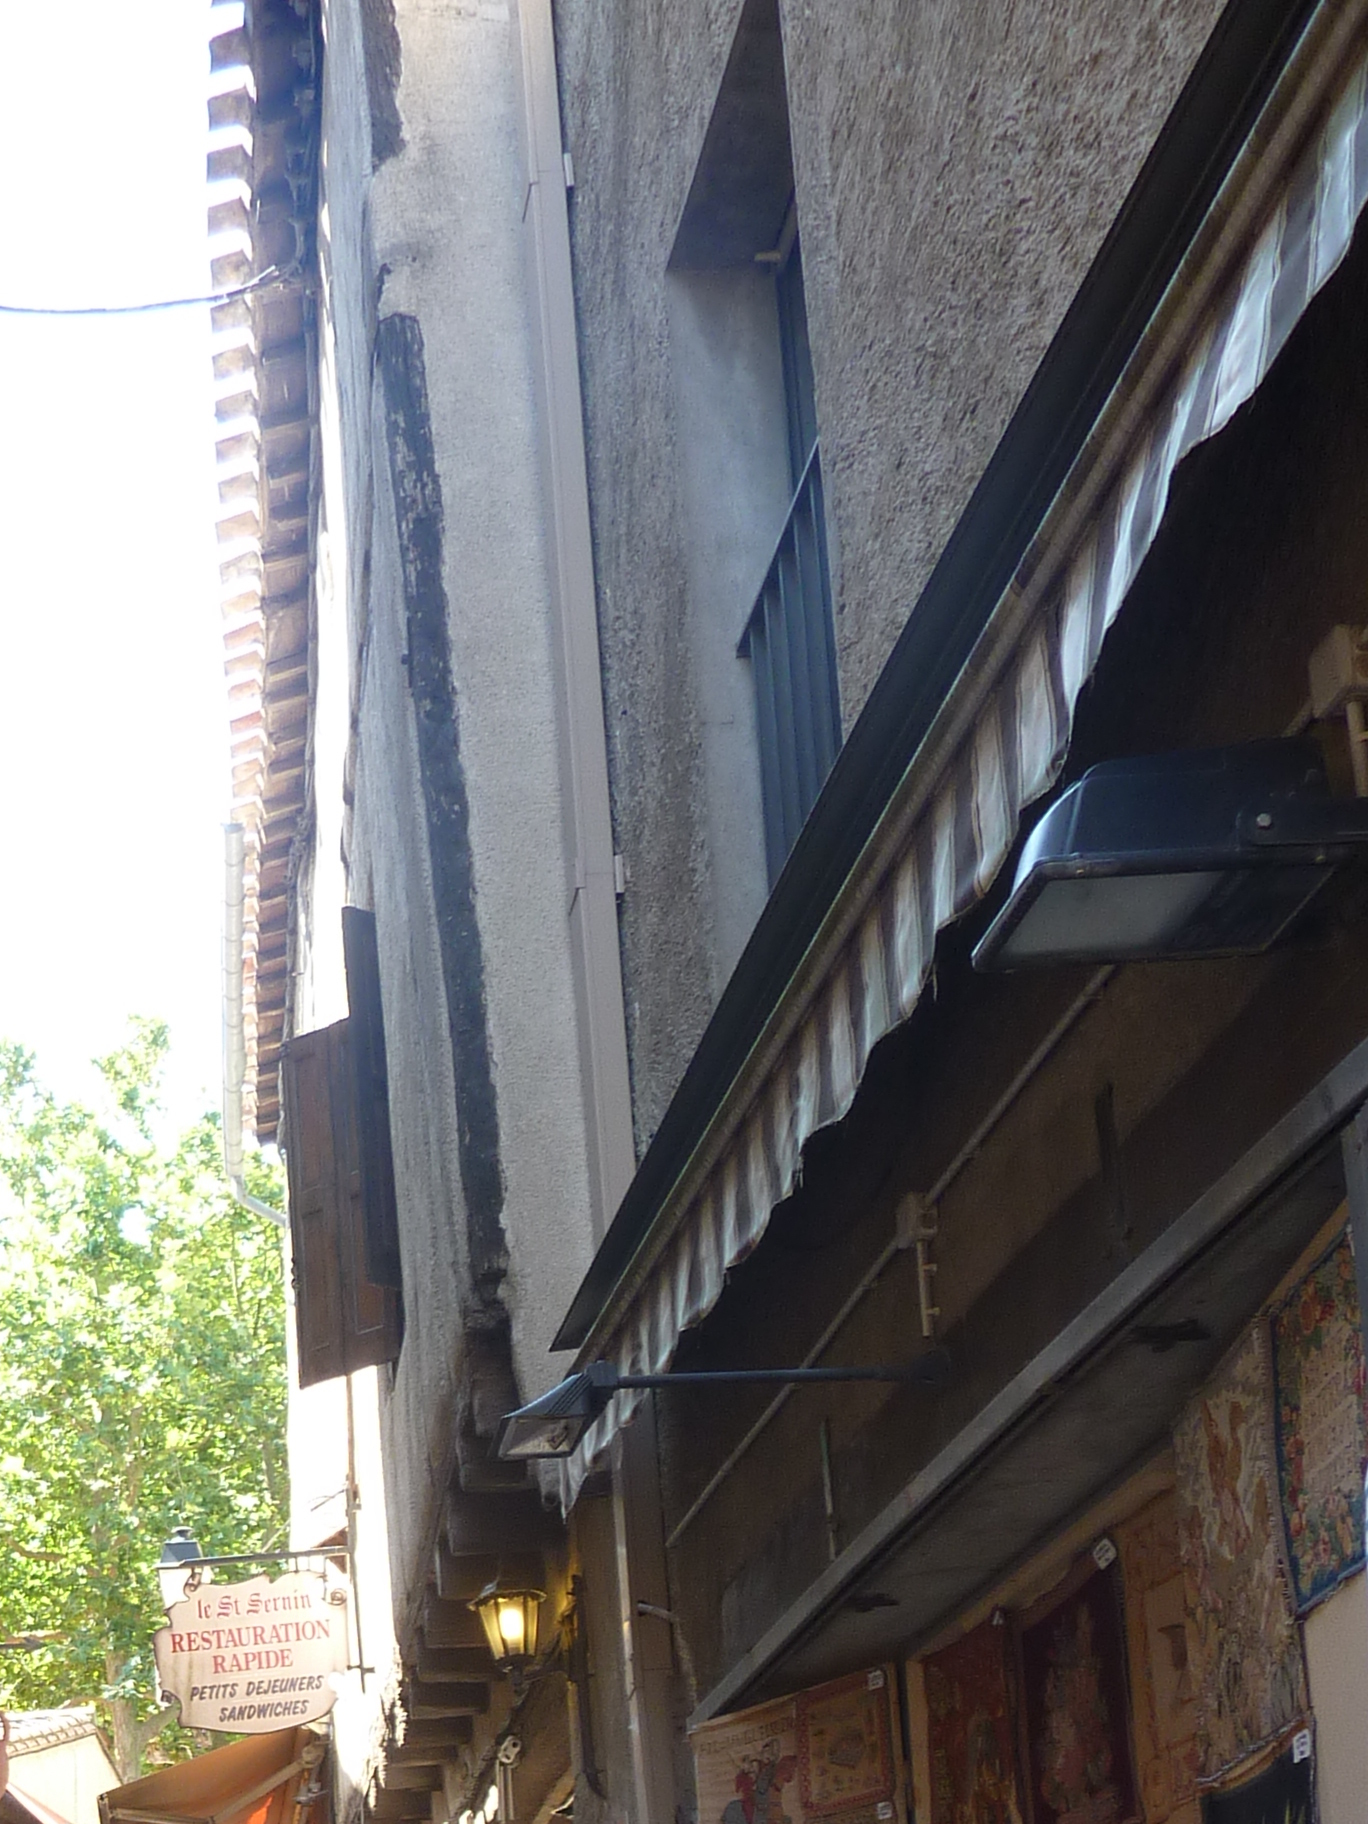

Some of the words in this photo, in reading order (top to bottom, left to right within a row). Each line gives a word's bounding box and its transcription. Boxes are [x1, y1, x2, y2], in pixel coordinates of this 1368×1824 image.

[198, 1599, 212, 1619] le
[217, 1595, 241, 1619] St
[246, 1589, 312, 1615] Sernin
[171, 1619, 331, 1653] RESTAURATION
[213, 1648, 294, 1674] RAPIDE
[190, 1682, 238, 1701] PETITS
[245, 1675, 325, 1696] DEJEUNERS
[219, 1699, 310, 1722] SANDWICHES
